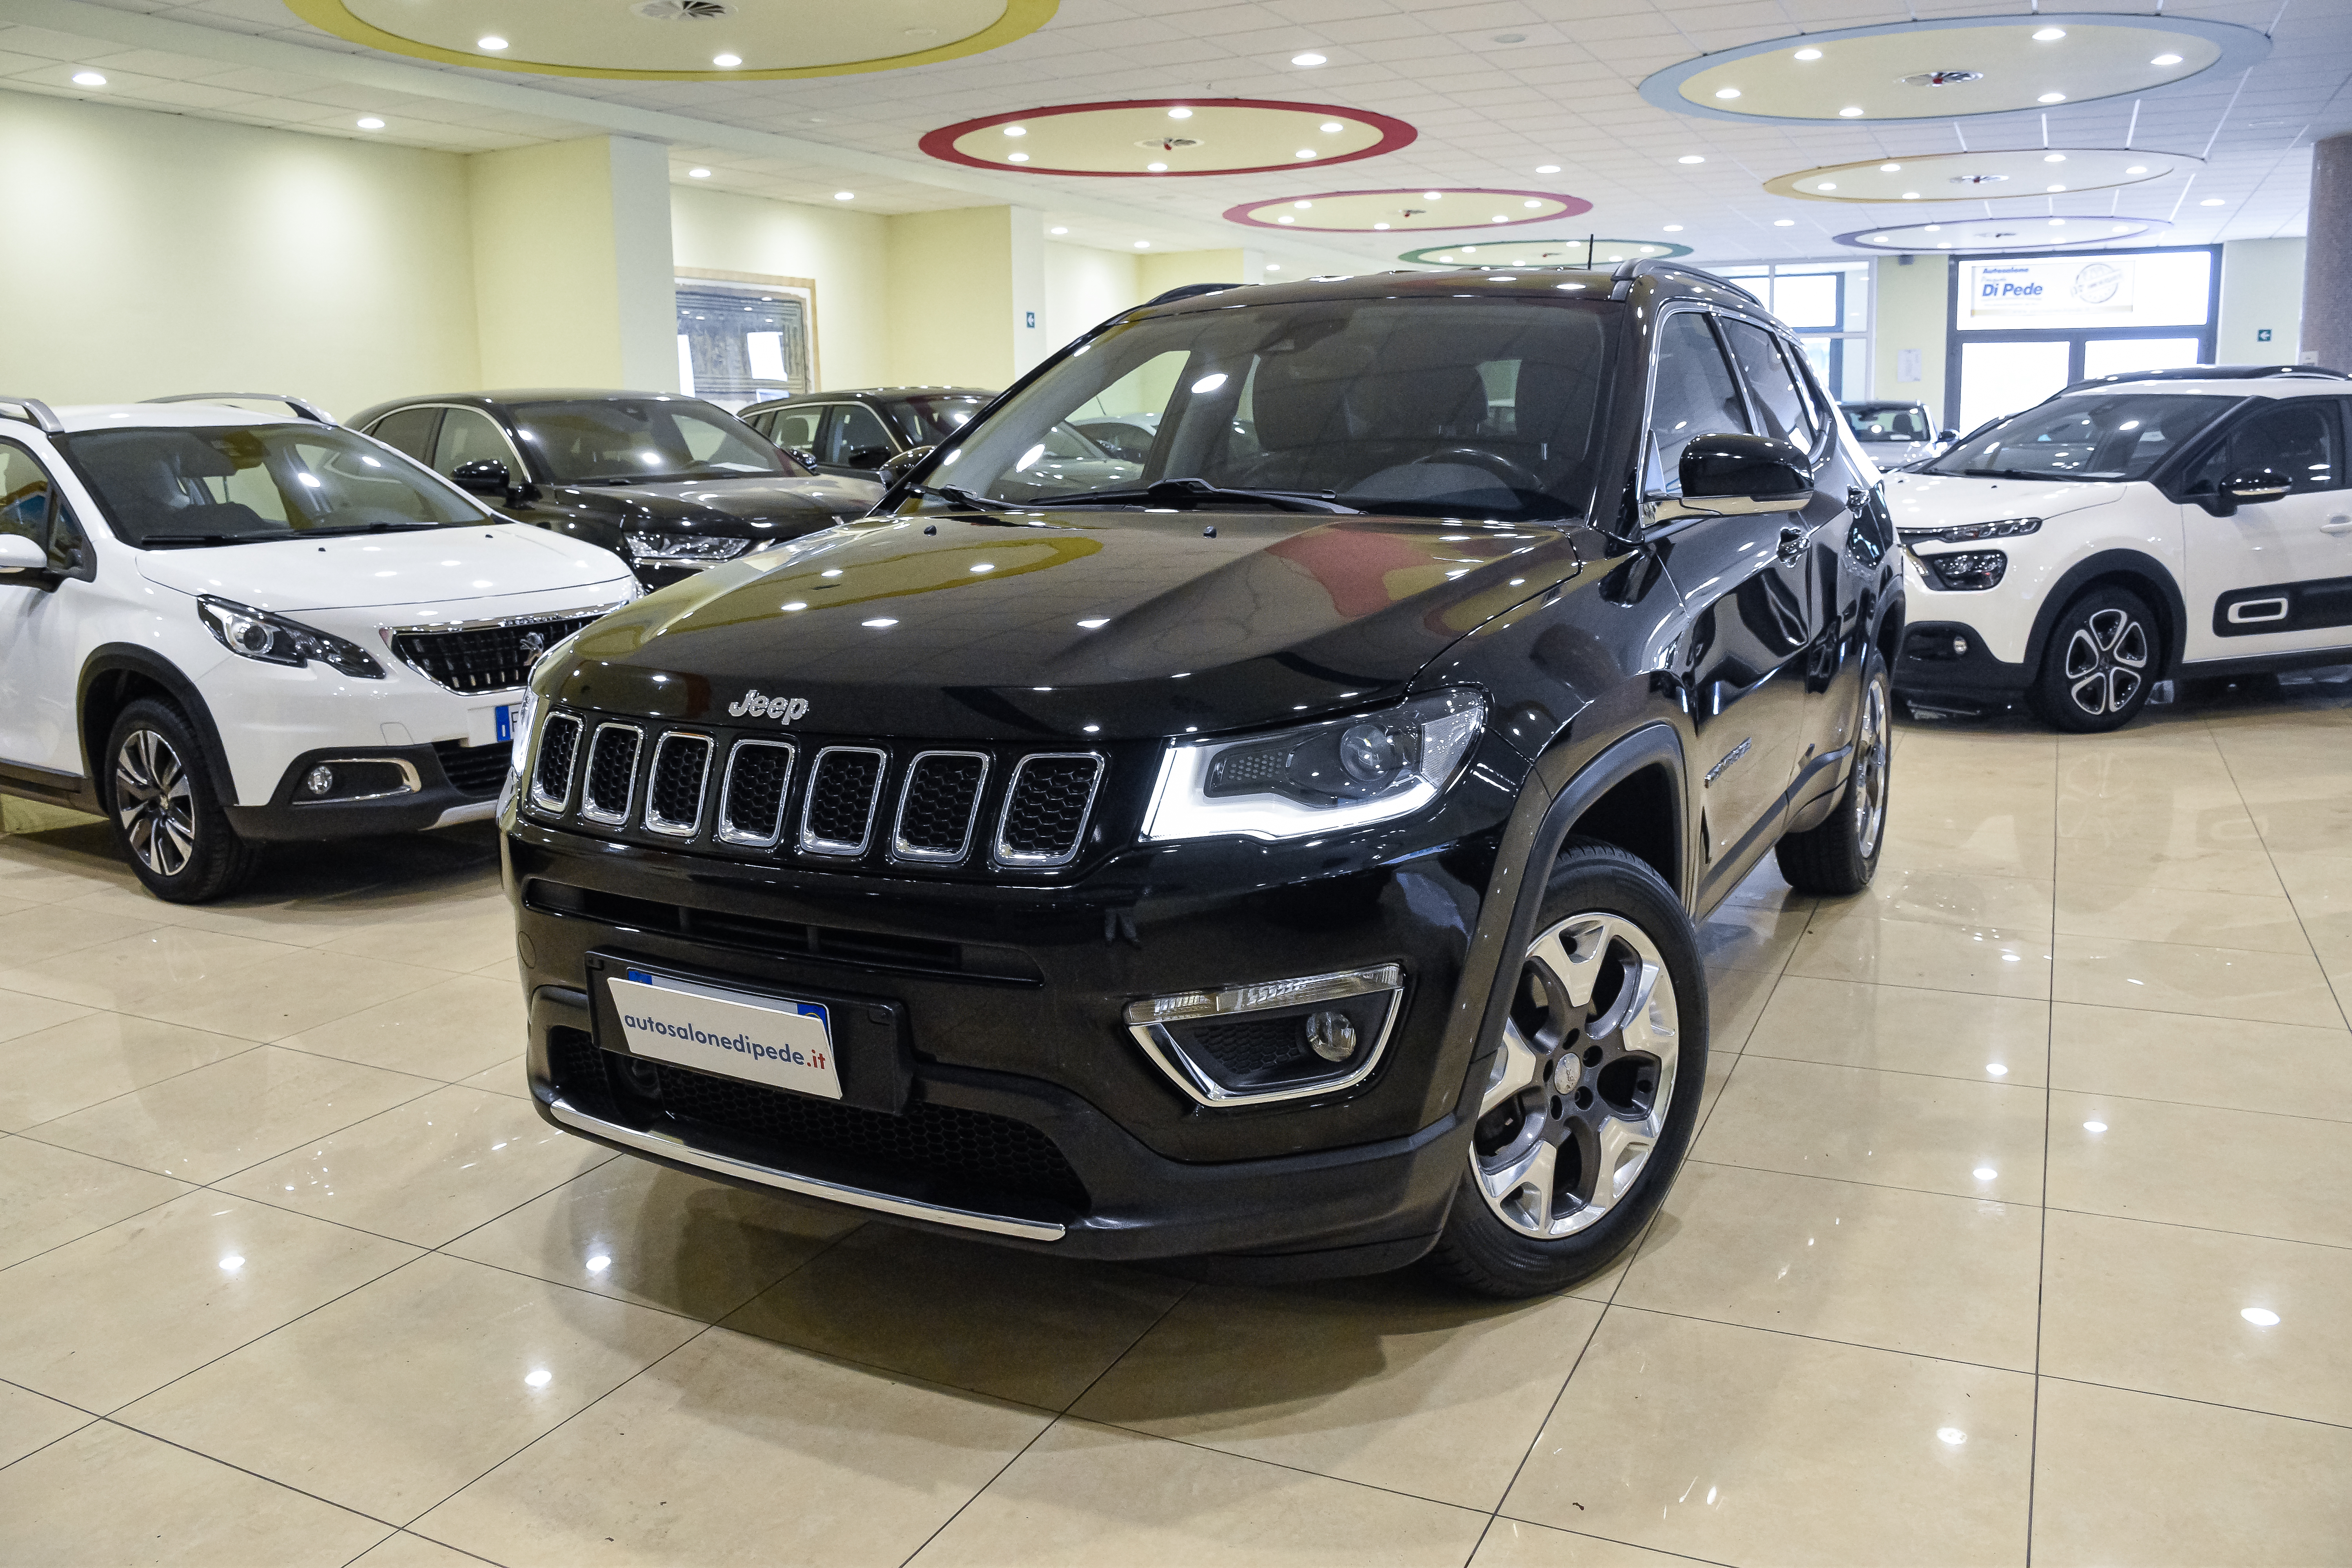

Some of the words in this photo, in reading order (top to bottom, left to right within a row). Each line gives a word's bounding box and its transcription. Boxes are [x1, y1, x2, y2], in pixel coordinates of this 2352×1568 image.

[1982, 284, 1999, 296] Di
[2003, 283, 2043, 296] Pede
[728, 690, 809, 725] Jeep
[624, 1014, 826, 1070] autosalonedipede.it
